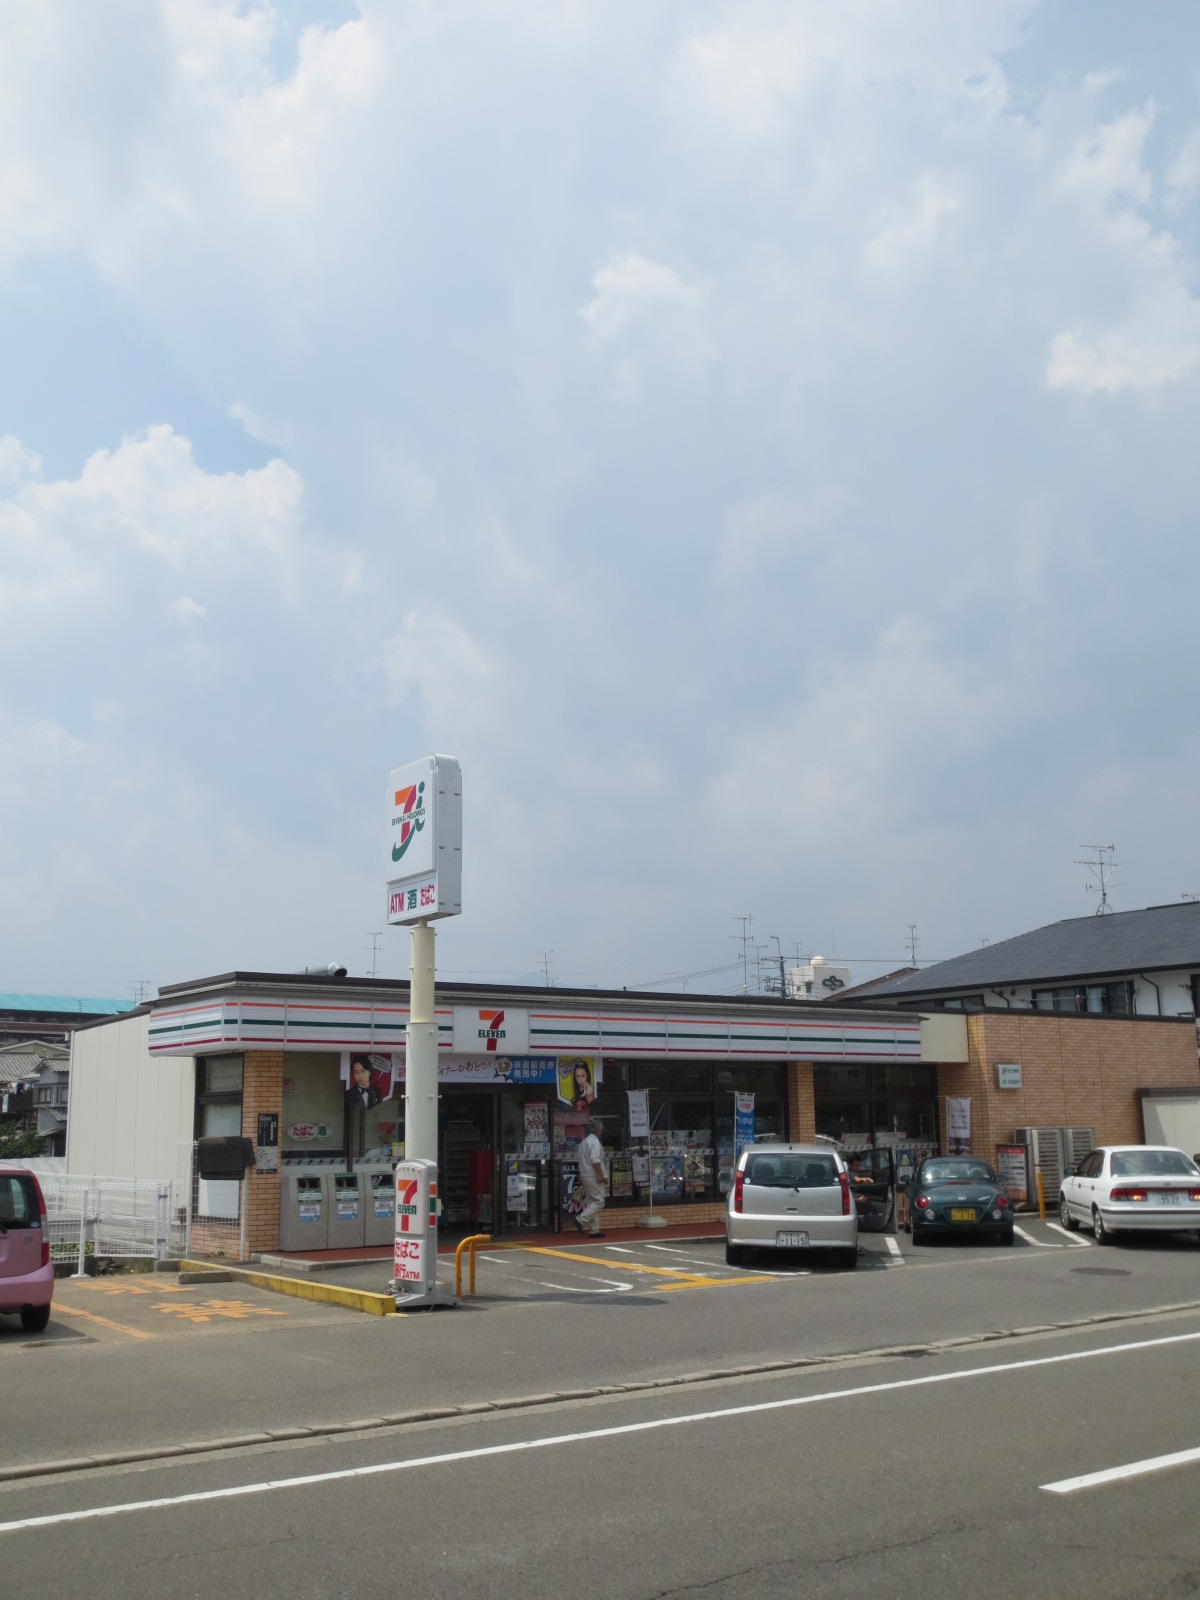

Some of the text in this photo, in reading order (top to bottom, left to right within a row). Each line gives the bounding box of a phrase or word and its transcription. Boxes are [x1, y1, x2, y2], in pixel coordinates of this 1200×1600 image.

[407, 807, 426, 821] HOLDINGS
[390, 884, 436, 914] ATM 酒 たばこ
[292, 1125, 314, 1137] たばこ
[395, 1240, 420, 1260] たばこ
